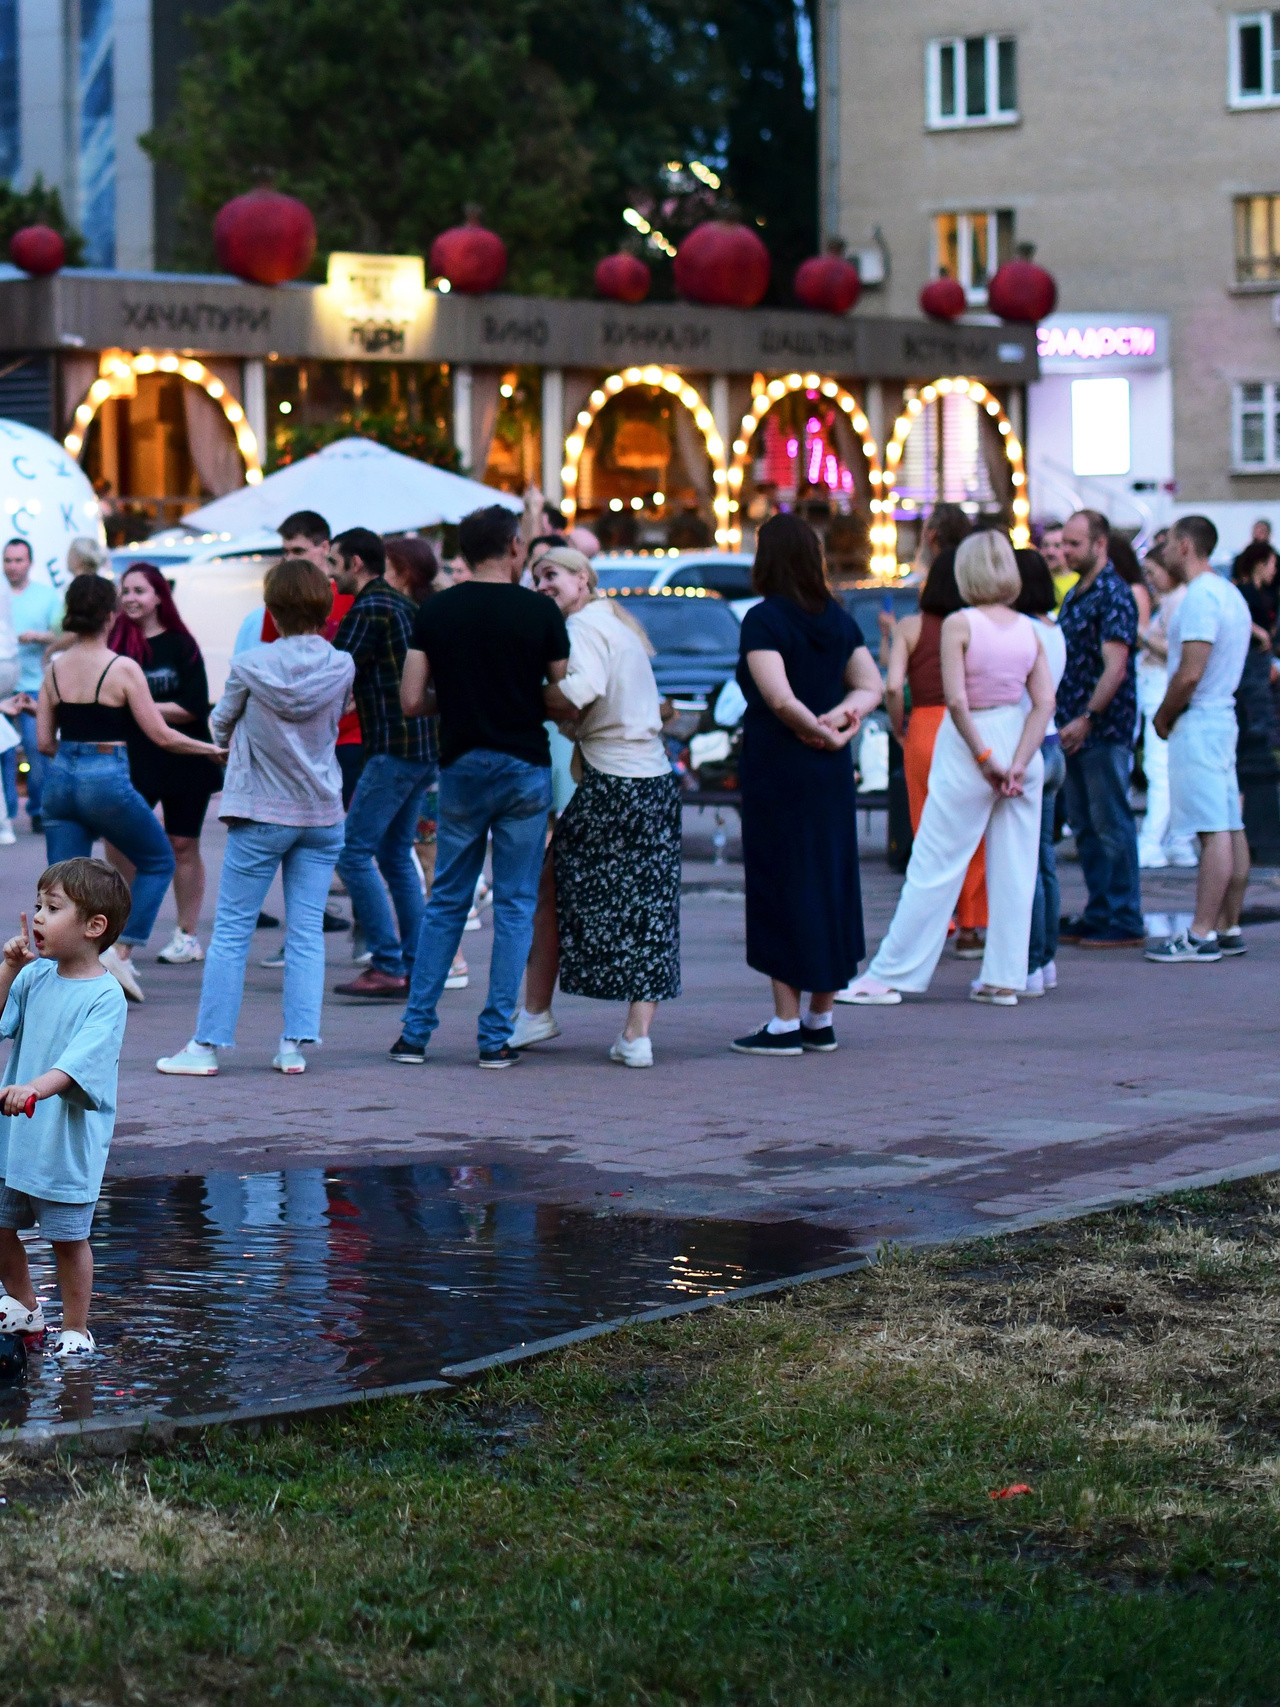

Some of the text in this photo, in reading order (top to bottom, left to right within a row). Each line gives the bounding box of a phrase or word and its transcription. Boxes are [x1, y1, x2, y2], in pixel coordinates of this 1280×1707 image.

[482, 315, 550, 348] ВИНО
[601, 319, 712, 348] ХИНКАЛИ
[1036, 327, 1155, 359] СЛАДОСТИ
